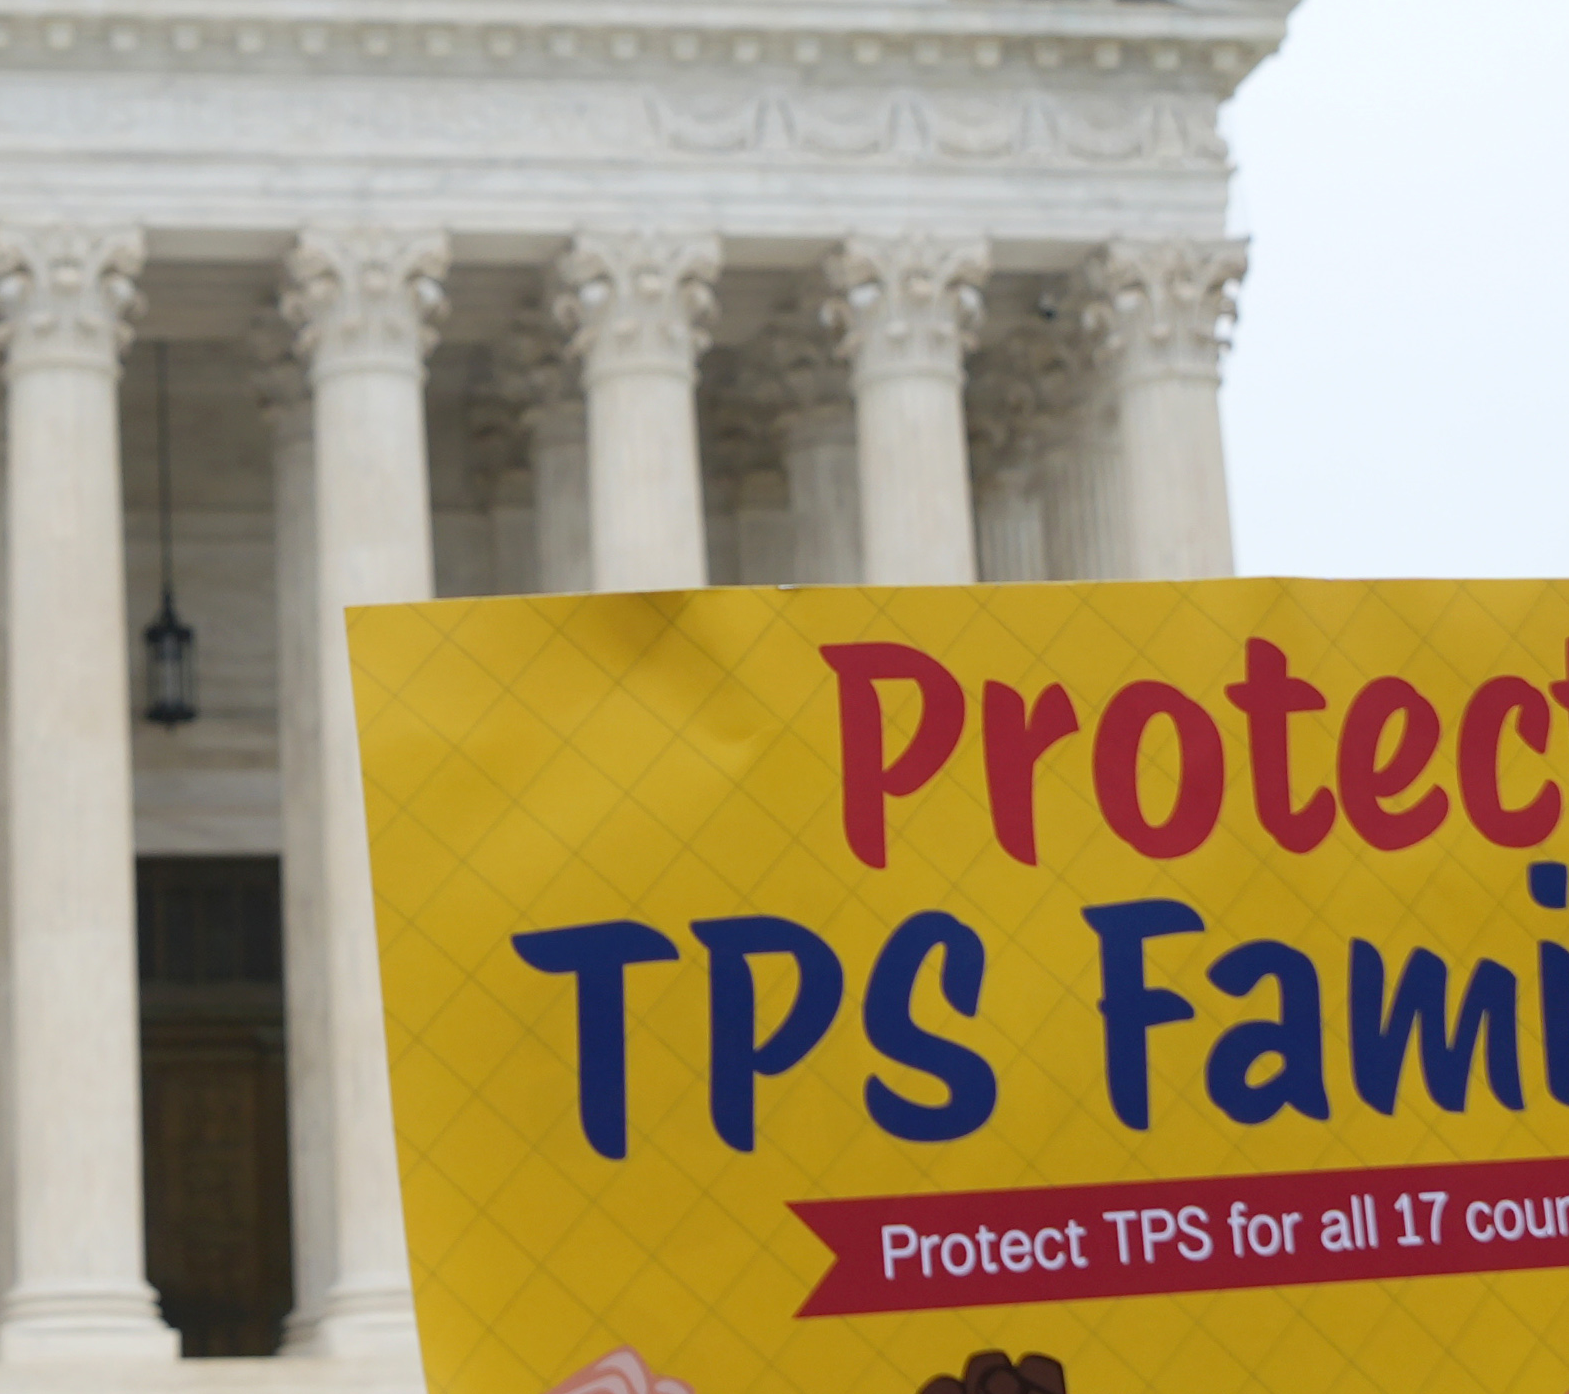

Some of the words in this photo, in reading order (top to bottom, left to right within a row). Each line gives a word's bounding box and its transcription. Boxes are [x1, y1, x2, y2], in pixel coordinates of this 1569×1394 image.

[513, 912, 997, 1159] TPS
[881, 1220, 1087, 1279] Protect
[1102, 1205, 1212, 1263] TPS
[1227, 1201, 1301, 1256] for
[1321, 1194, 1378, 1251] all
[1394, 1191, 1448, 1245] 17
